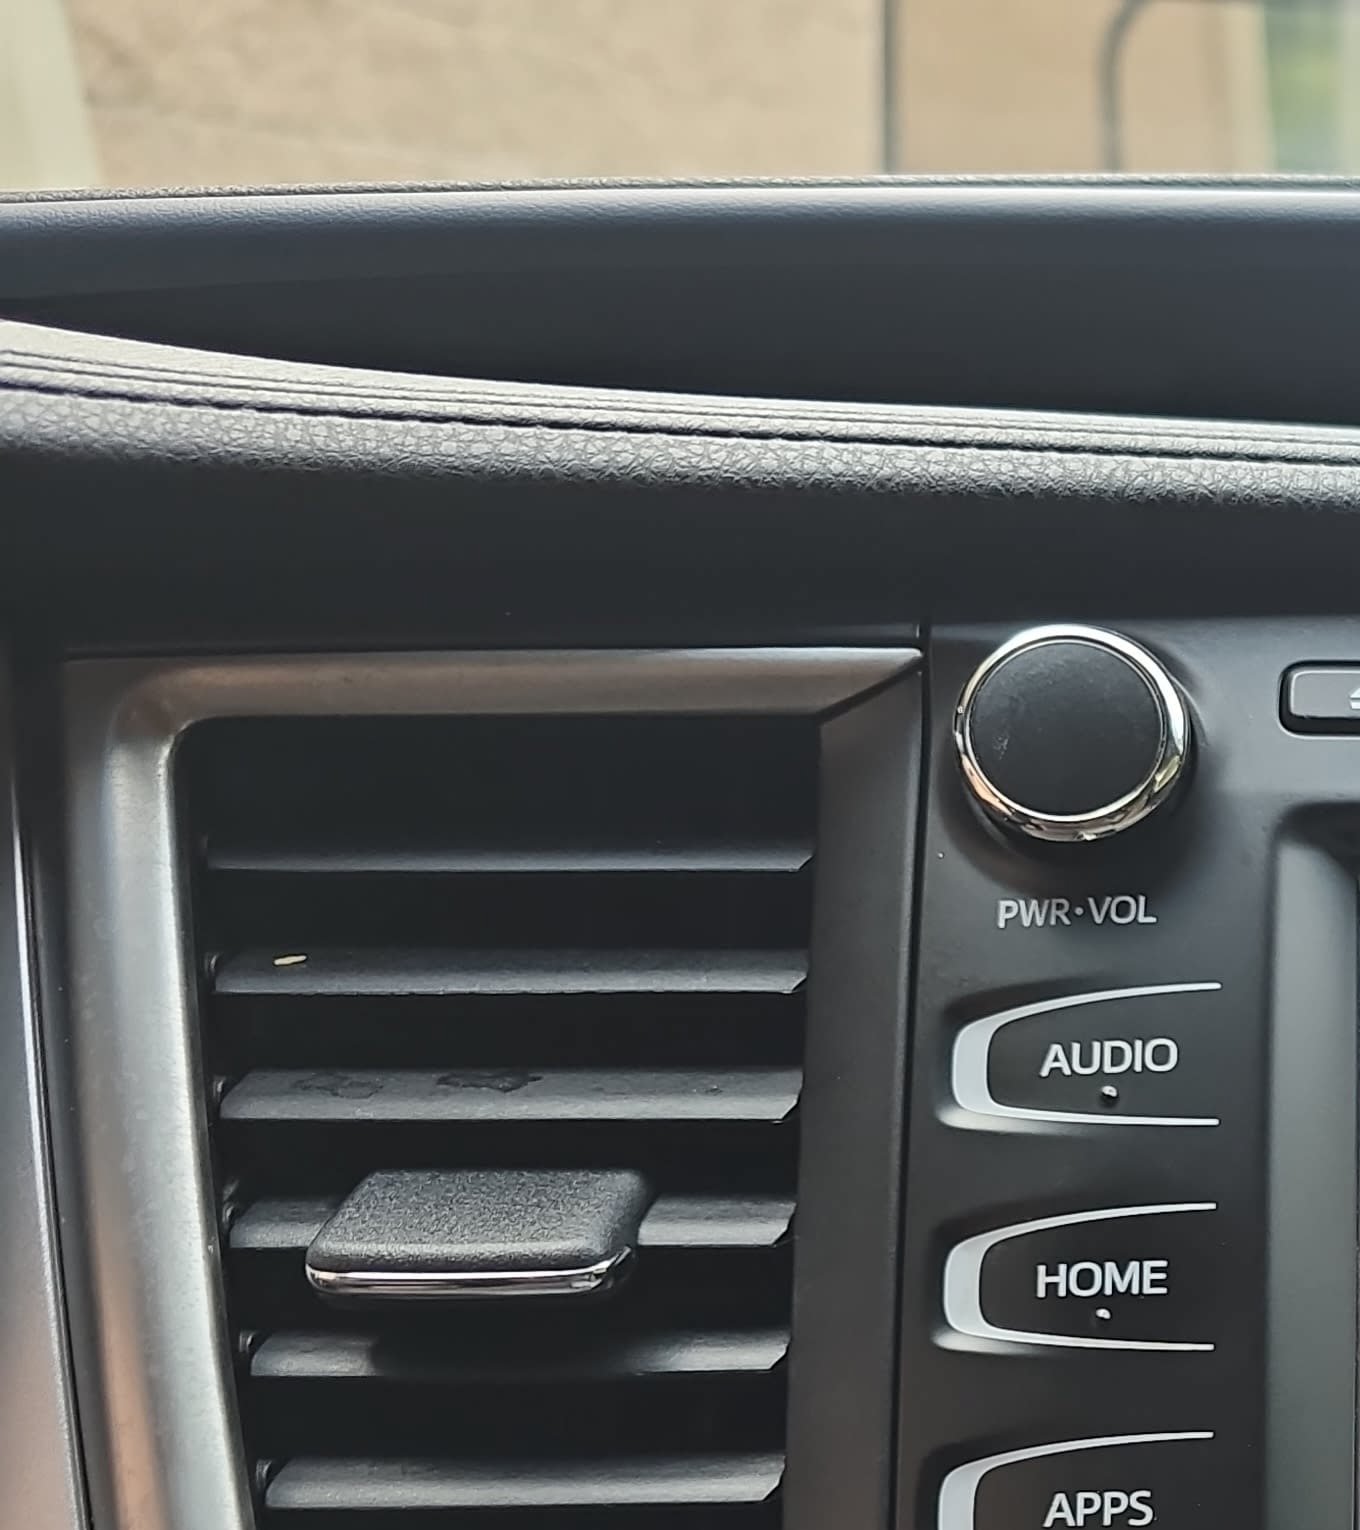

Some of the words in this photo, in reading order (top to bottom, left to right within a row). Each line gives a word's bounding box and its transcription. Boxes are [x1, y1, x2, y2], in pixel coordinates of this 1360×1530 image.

[1039, 1038, 1179, 1077] AUDIO
[1036, 1260, 1169, 1297] HOME
[1043, 1490, 1154, 1528] APPS
